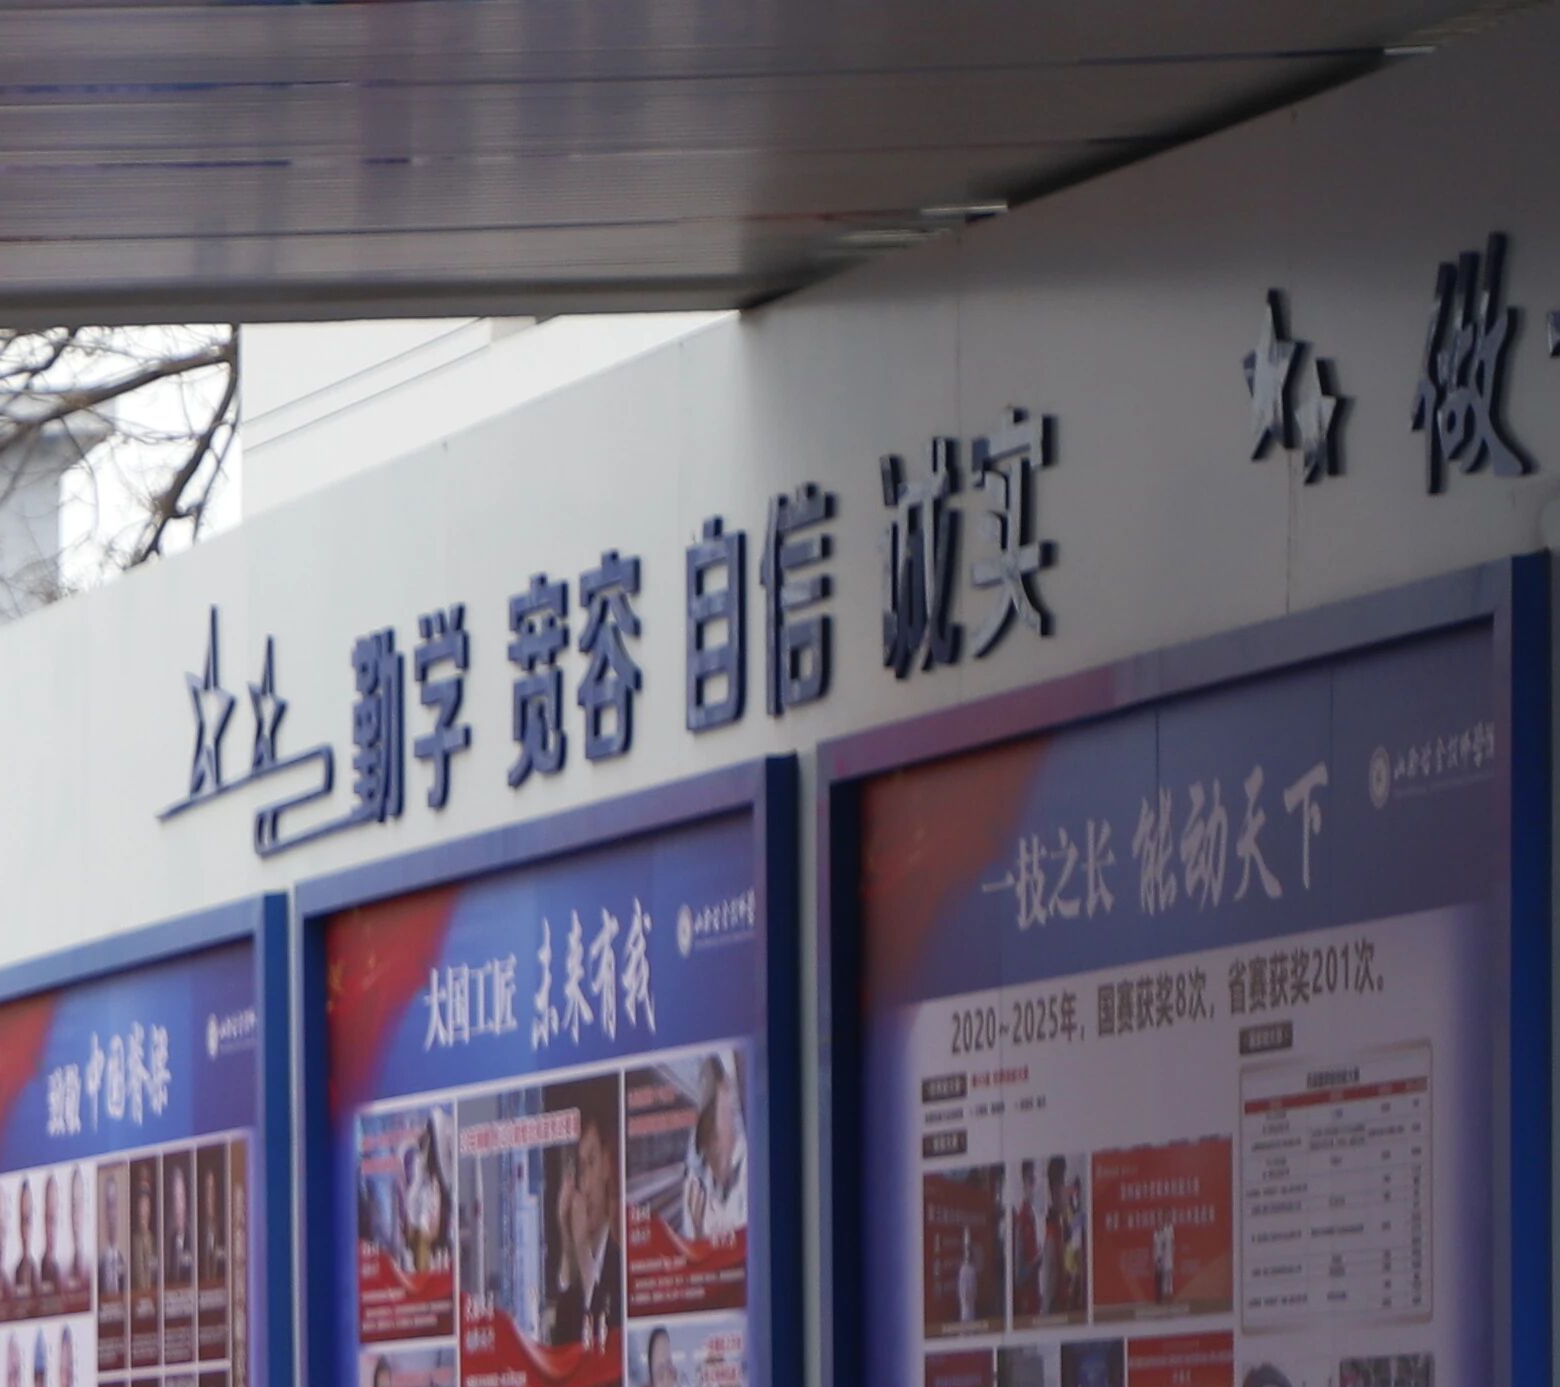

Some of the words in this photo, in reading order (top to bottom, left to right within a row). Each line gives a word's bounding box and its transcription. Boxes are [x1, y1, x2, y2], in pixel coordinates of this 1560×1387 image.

[350, 603, 471, 824] 勤学
[507, 548, 643, 790] 宽容
[685, 480, 836, 734] 自信
[880, 405, 1058, 678] 诚实
[981, 818, 1116, 931] 一技之长
[1132, 760, 1329, 916] 能动天下
[424, 953, 518, 1052] 大国工匠
[531, 896, 657, 1050] 未来有我
